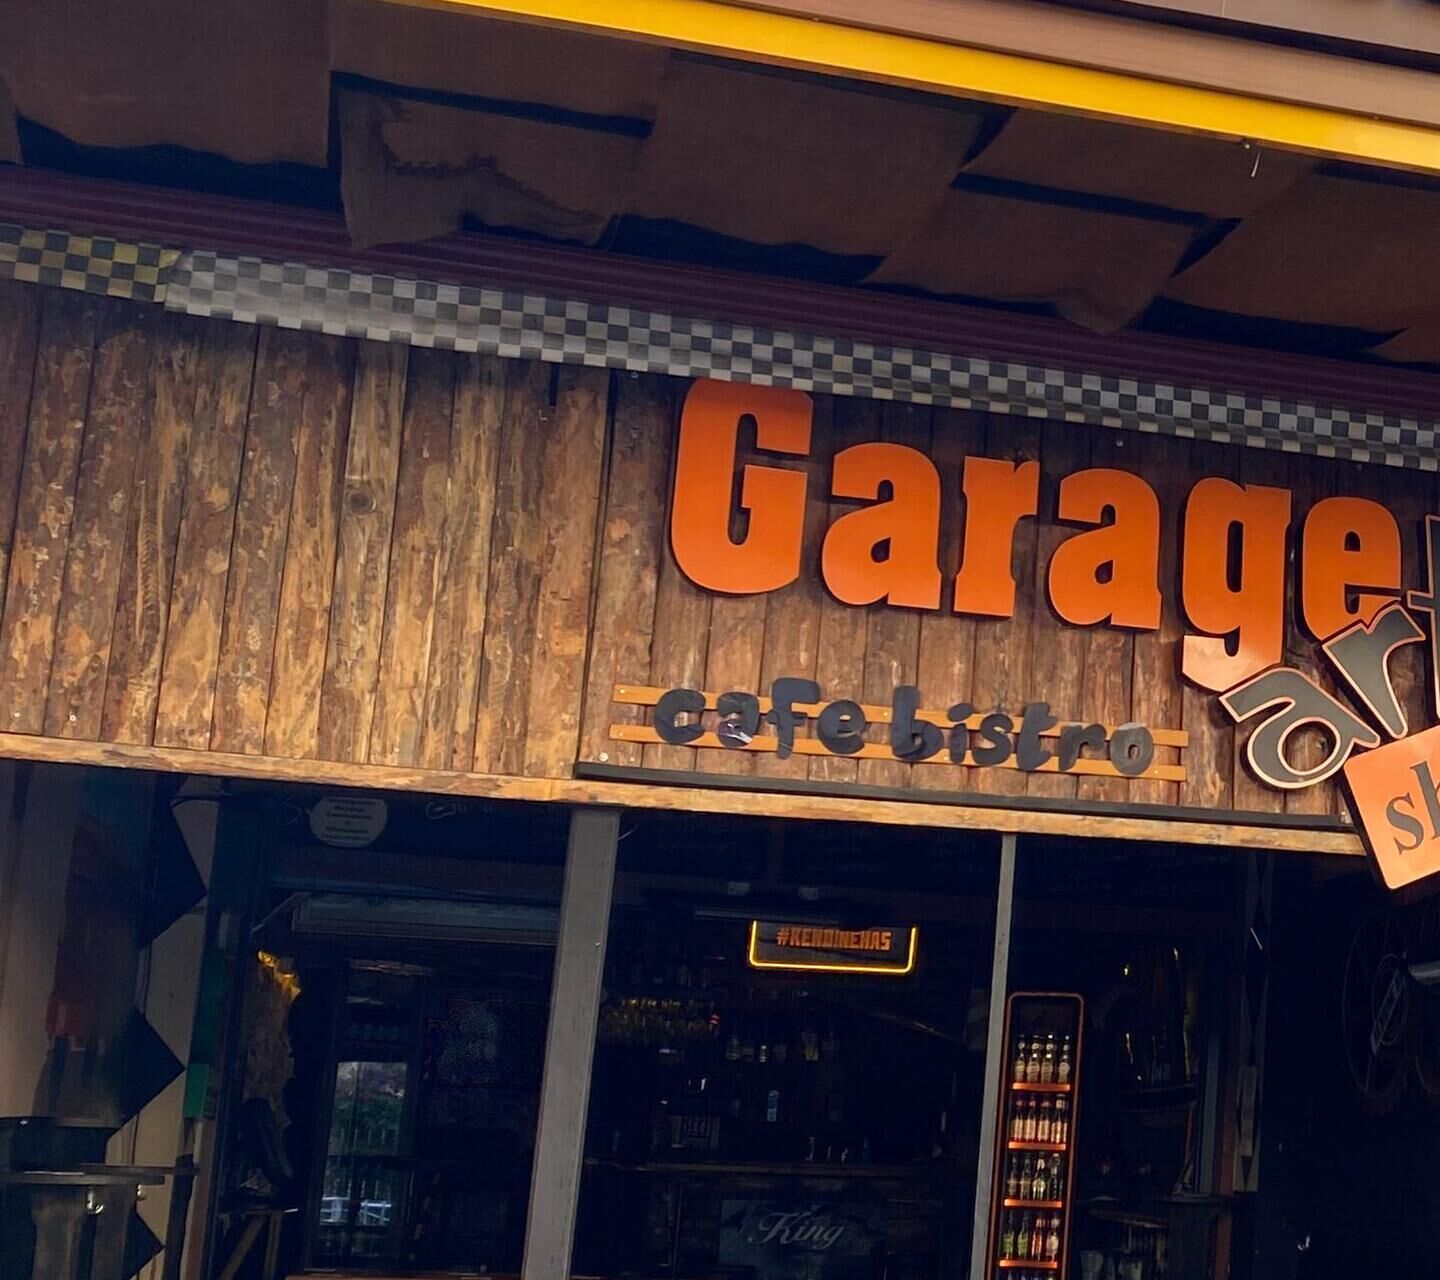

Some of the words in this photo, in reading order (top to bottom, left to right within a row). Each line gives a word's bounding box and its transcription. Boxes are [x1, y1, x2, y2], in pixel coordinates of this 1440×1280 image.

[668, 377, 1402, 692] Garage
[654, 676, 868, 761] cafe
[892, 685, 1154, 777] bistro
